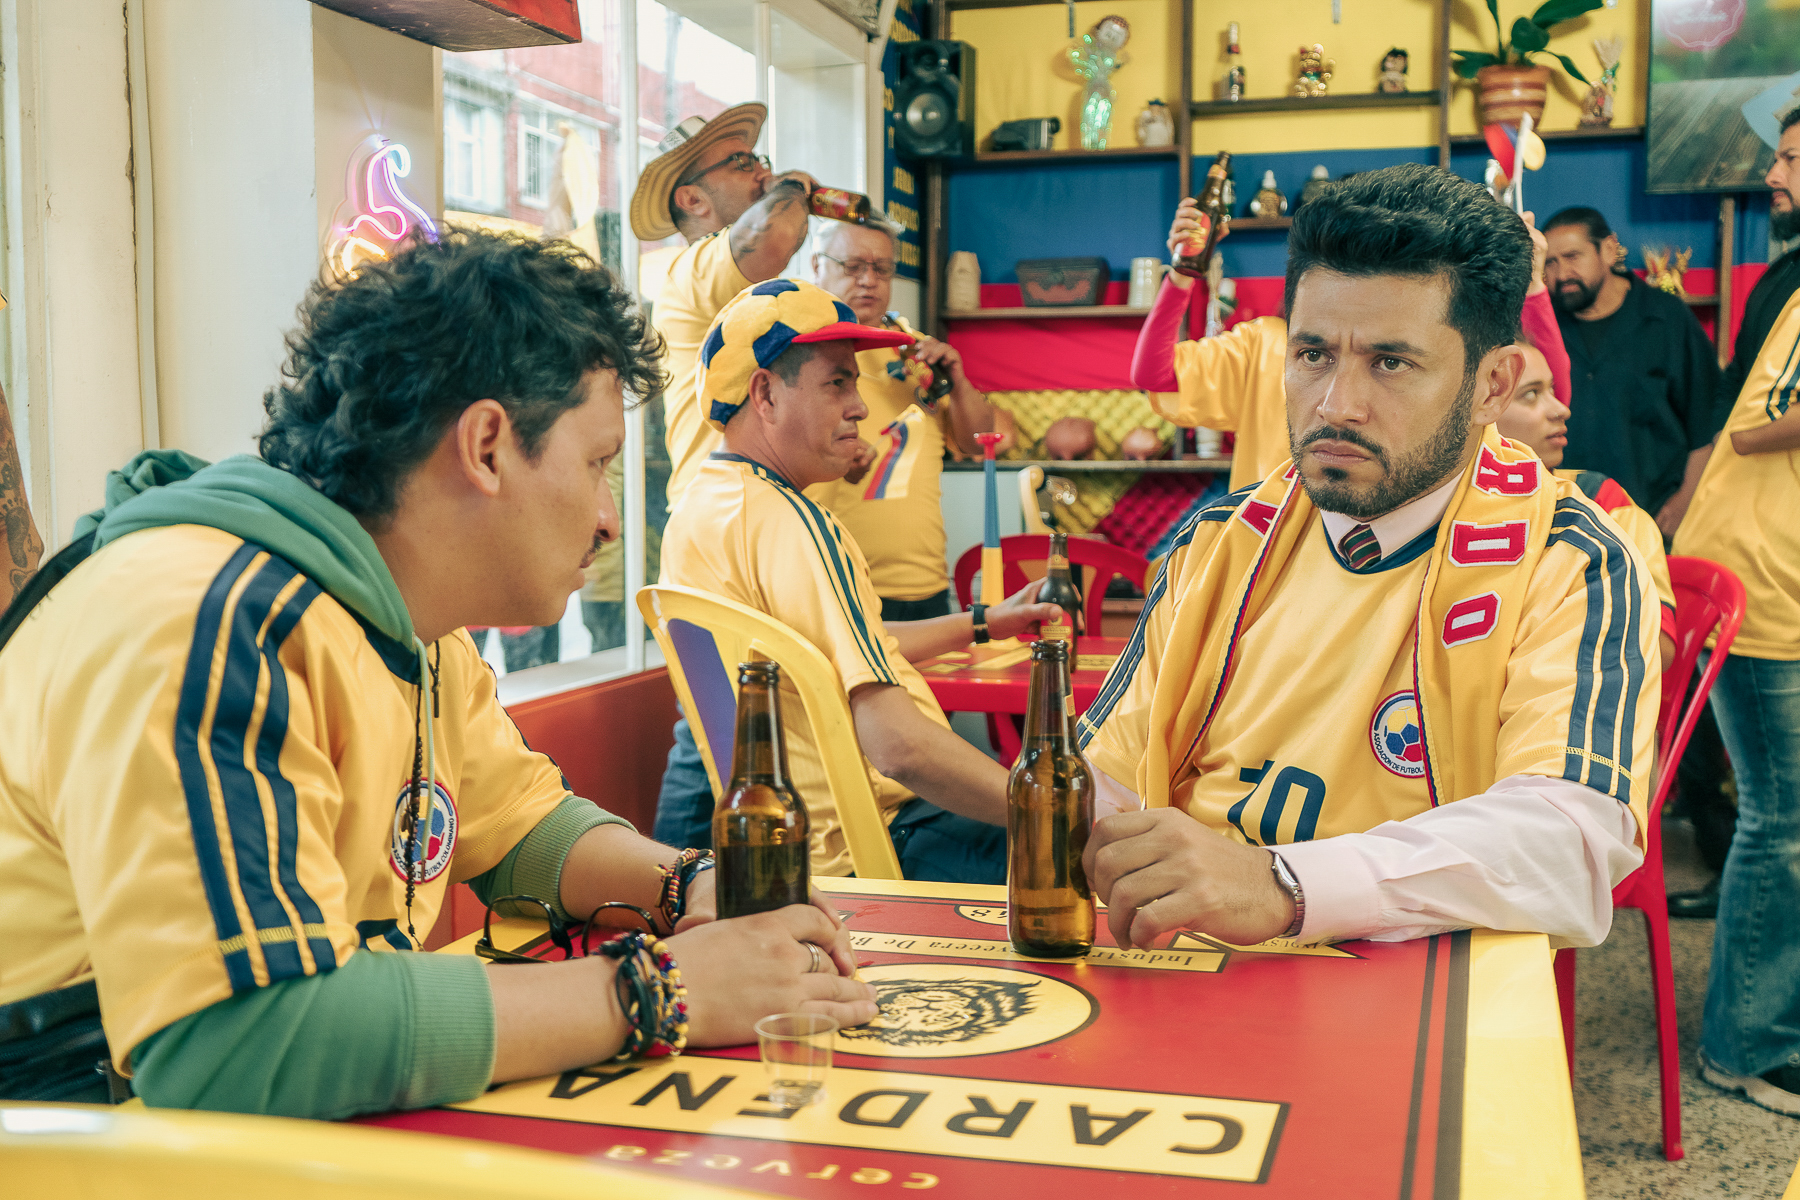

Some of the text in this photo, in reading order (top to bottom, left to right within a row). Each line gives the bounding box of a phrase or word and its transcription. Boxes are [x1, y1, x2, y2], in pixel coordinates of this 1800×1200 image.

[1373, 732, 1423, 774] ASOCIACION DE FUTBOL
[884, 938, 917, 950] De
[929, 941, 1014, 954] vecera
[1258, 939, 1318, 950] INDUST
[1082, 951, 1193, 966] Industr
[604, 1144, 942, 1191] cerveza
